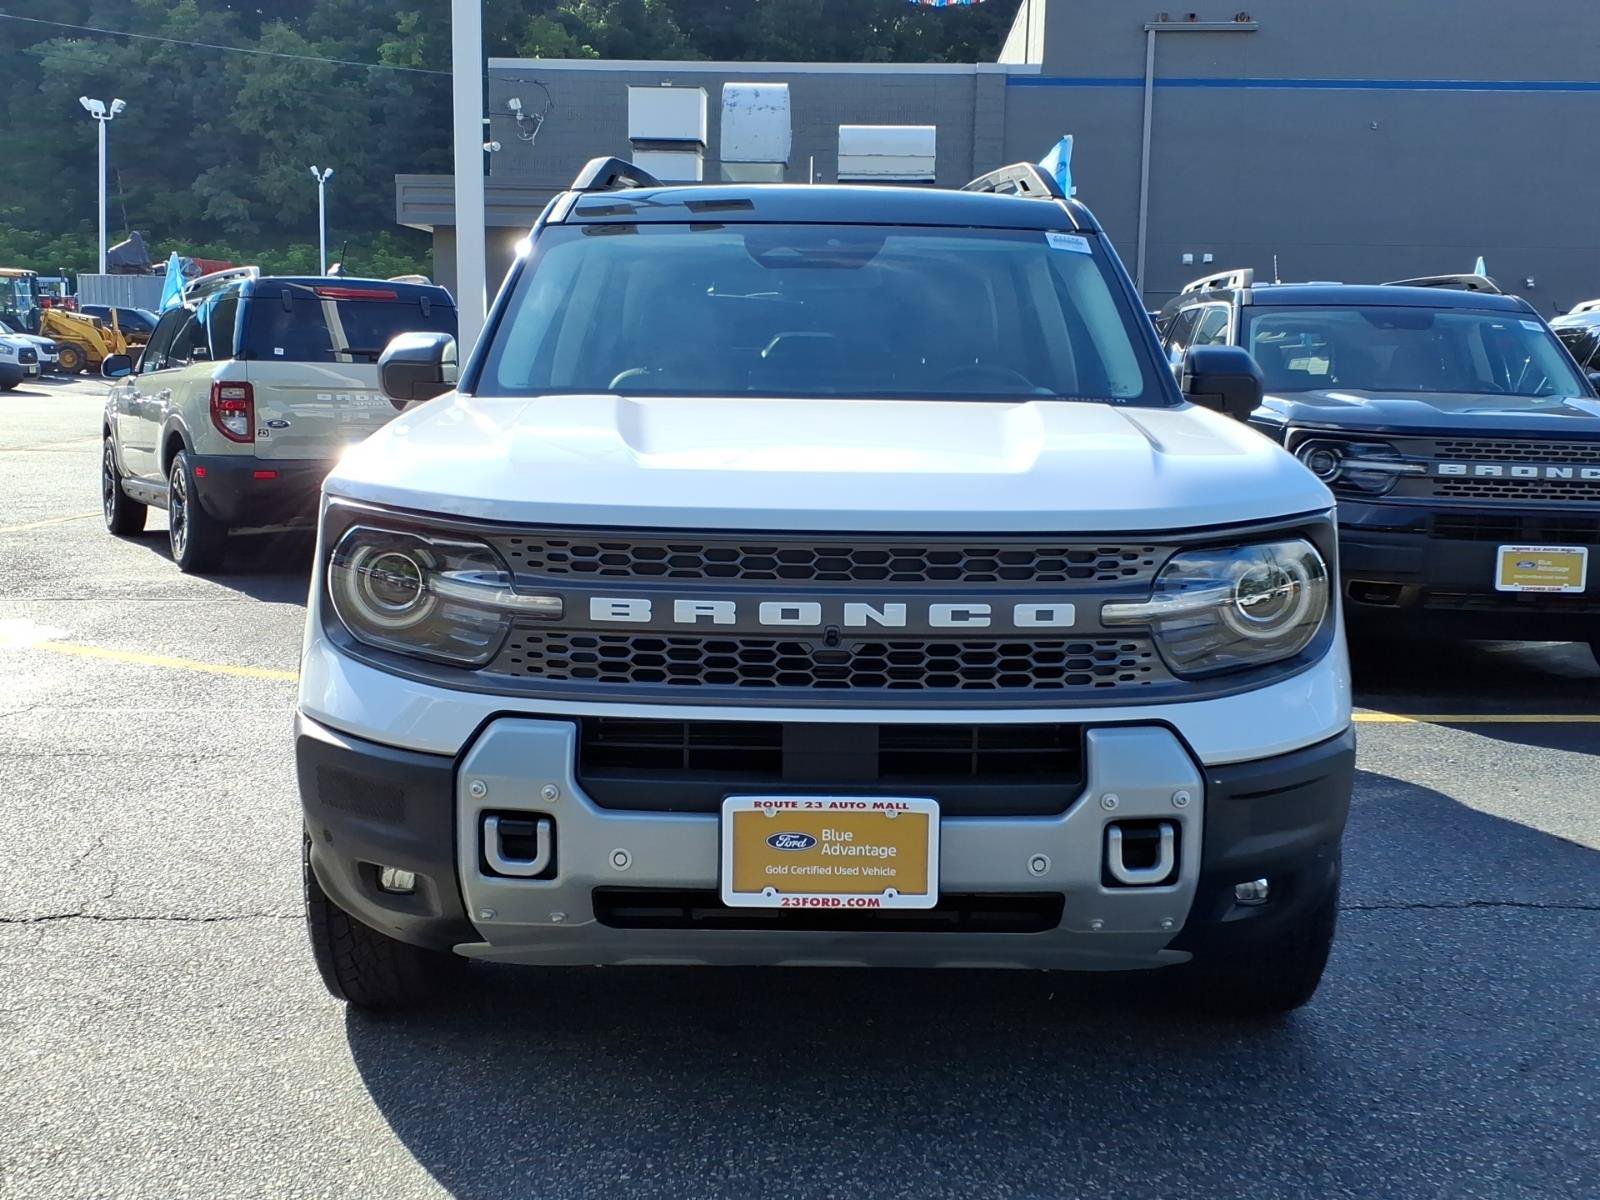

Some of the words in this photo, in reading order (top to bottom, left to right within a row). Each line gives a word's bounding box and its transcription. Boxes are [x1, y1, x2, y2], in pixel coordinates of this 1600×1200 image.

[589, 597, 1076, 627] BRONCO
[753, 800, 798, 809] ROUTE
[804, 801, 823, 809] 23
[828, 801, 867, 809] AUTO
[872, 802, 910, 810] MALL
[775, 834, 807, 849] Ford
[821, 829, 854, 842] Blue
[821, 843, 897, 859] Advantage
[765, 865, 788, 875] Gold
[790, 865, 832, 875] Certified
[834, 866, 859, 876] Used
[861, 866, 897, 876] Vehicle
[780, 896, 881, 908] 23FORD.COM
